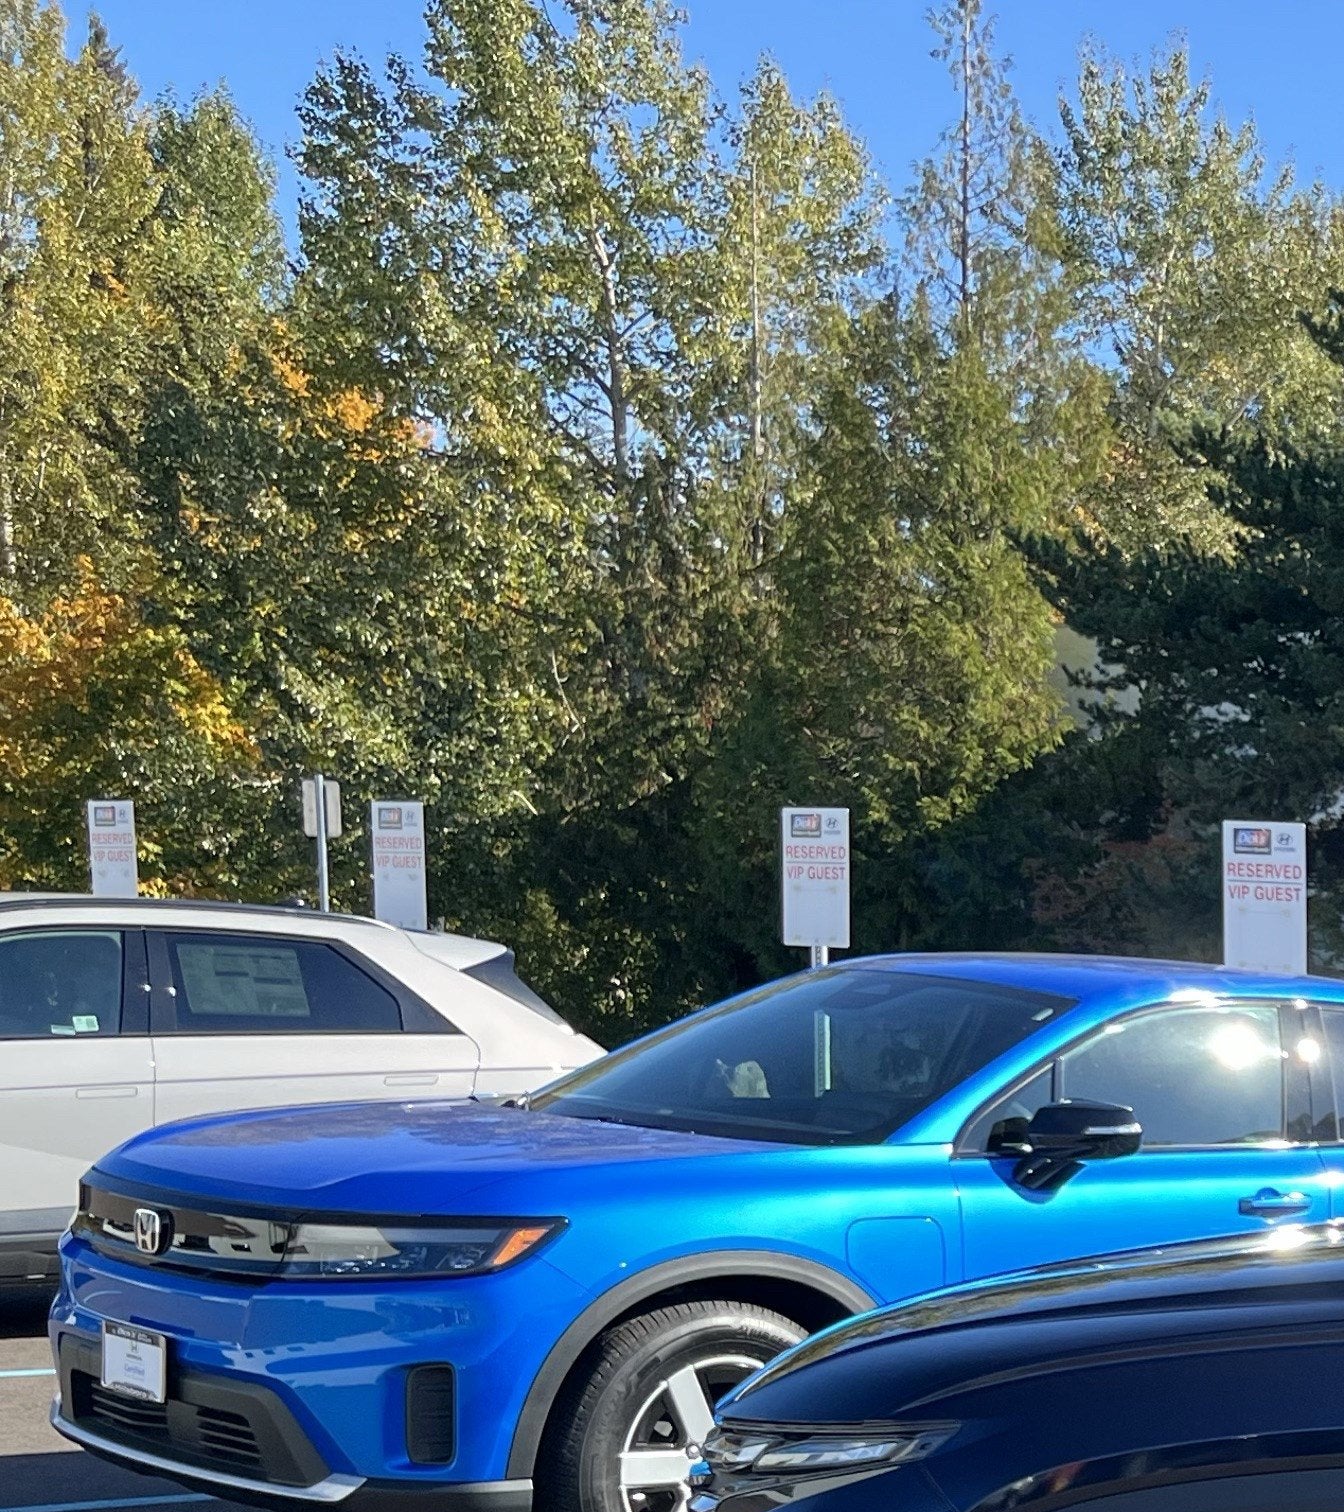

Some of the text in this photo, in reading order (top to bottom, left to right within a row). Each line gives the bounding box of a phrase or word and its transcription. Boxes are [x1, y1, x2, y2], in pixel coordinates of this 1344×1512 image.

[785, 845, 846, 859] RESERVED
[787, 866, 846, 880] VIP GUEST
[1227, 862, 1302, 879] RESERVED
[1228, 885, 1302, 902] VIP GUEST
